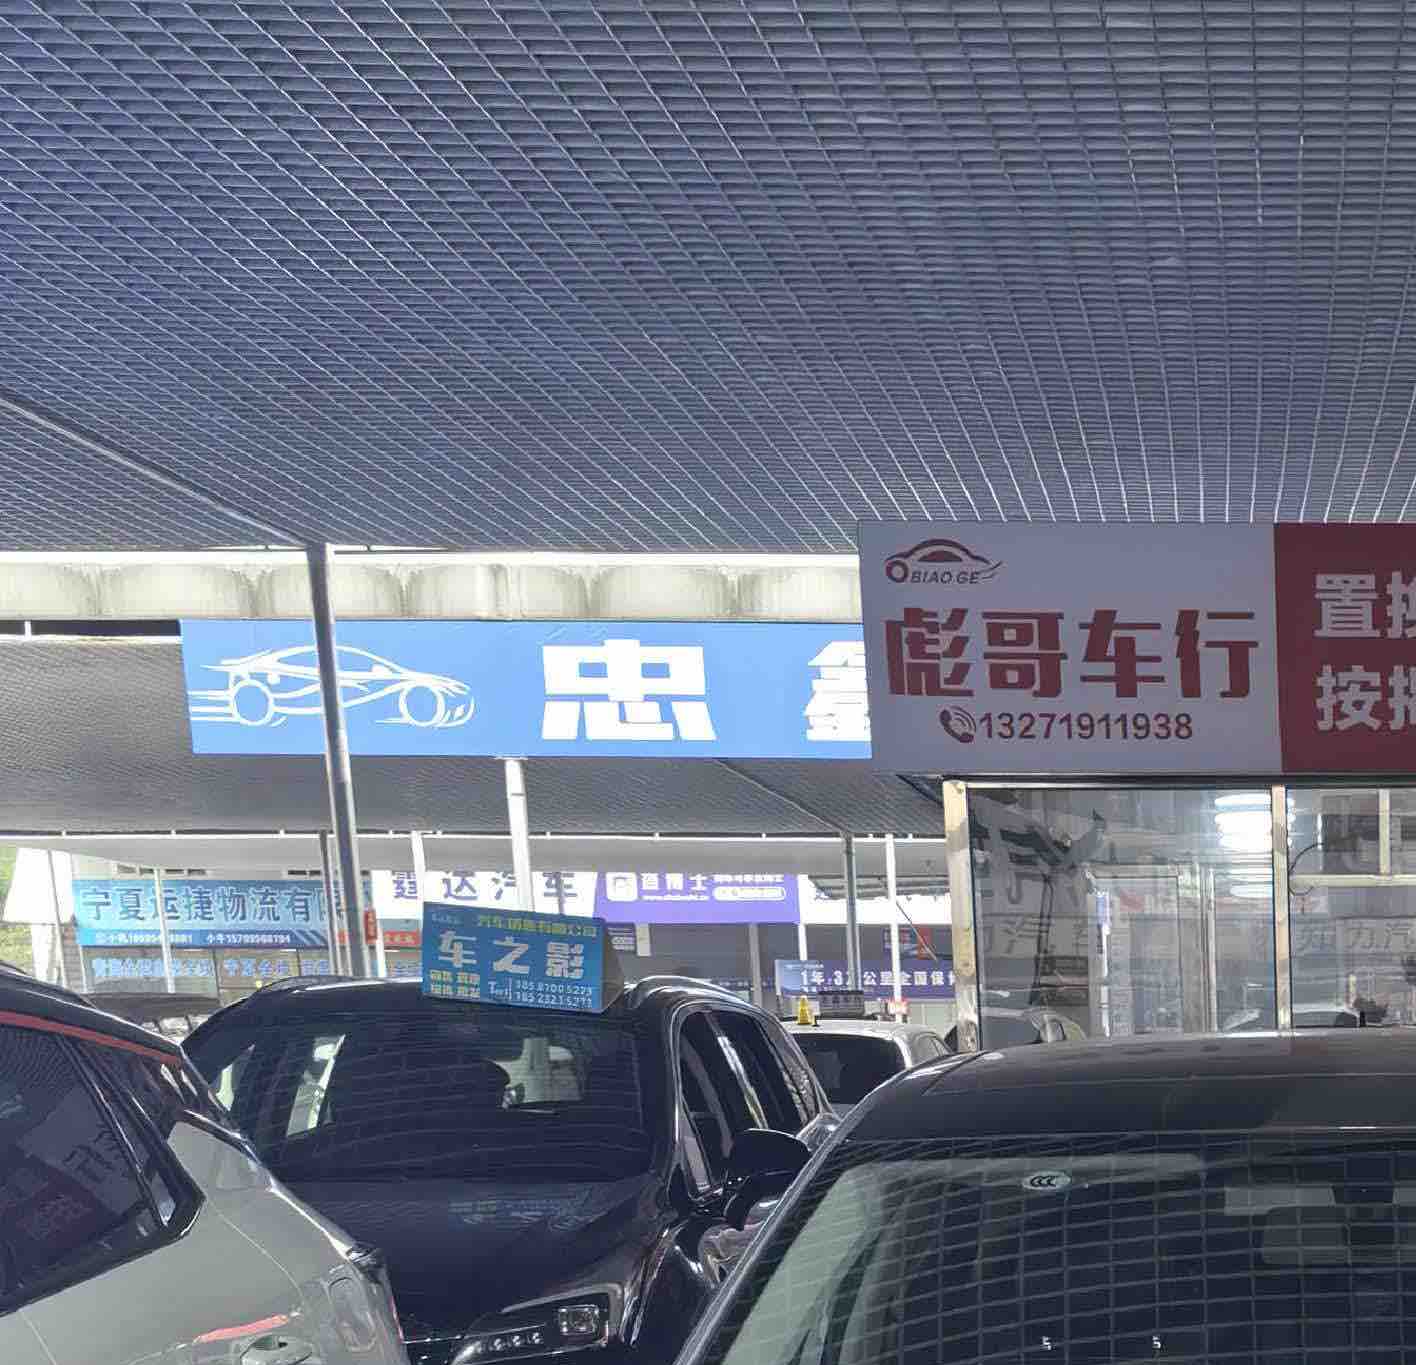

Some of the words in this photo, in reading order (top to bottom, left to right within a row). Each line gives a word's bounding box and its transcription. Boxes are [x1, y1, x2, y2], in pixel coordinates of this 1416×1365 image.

[884, 607, 1260, 699] 彪哥车行
[978, 712, 1194, 741] 13271911938
[436, 929, 586, 981] 车之影
